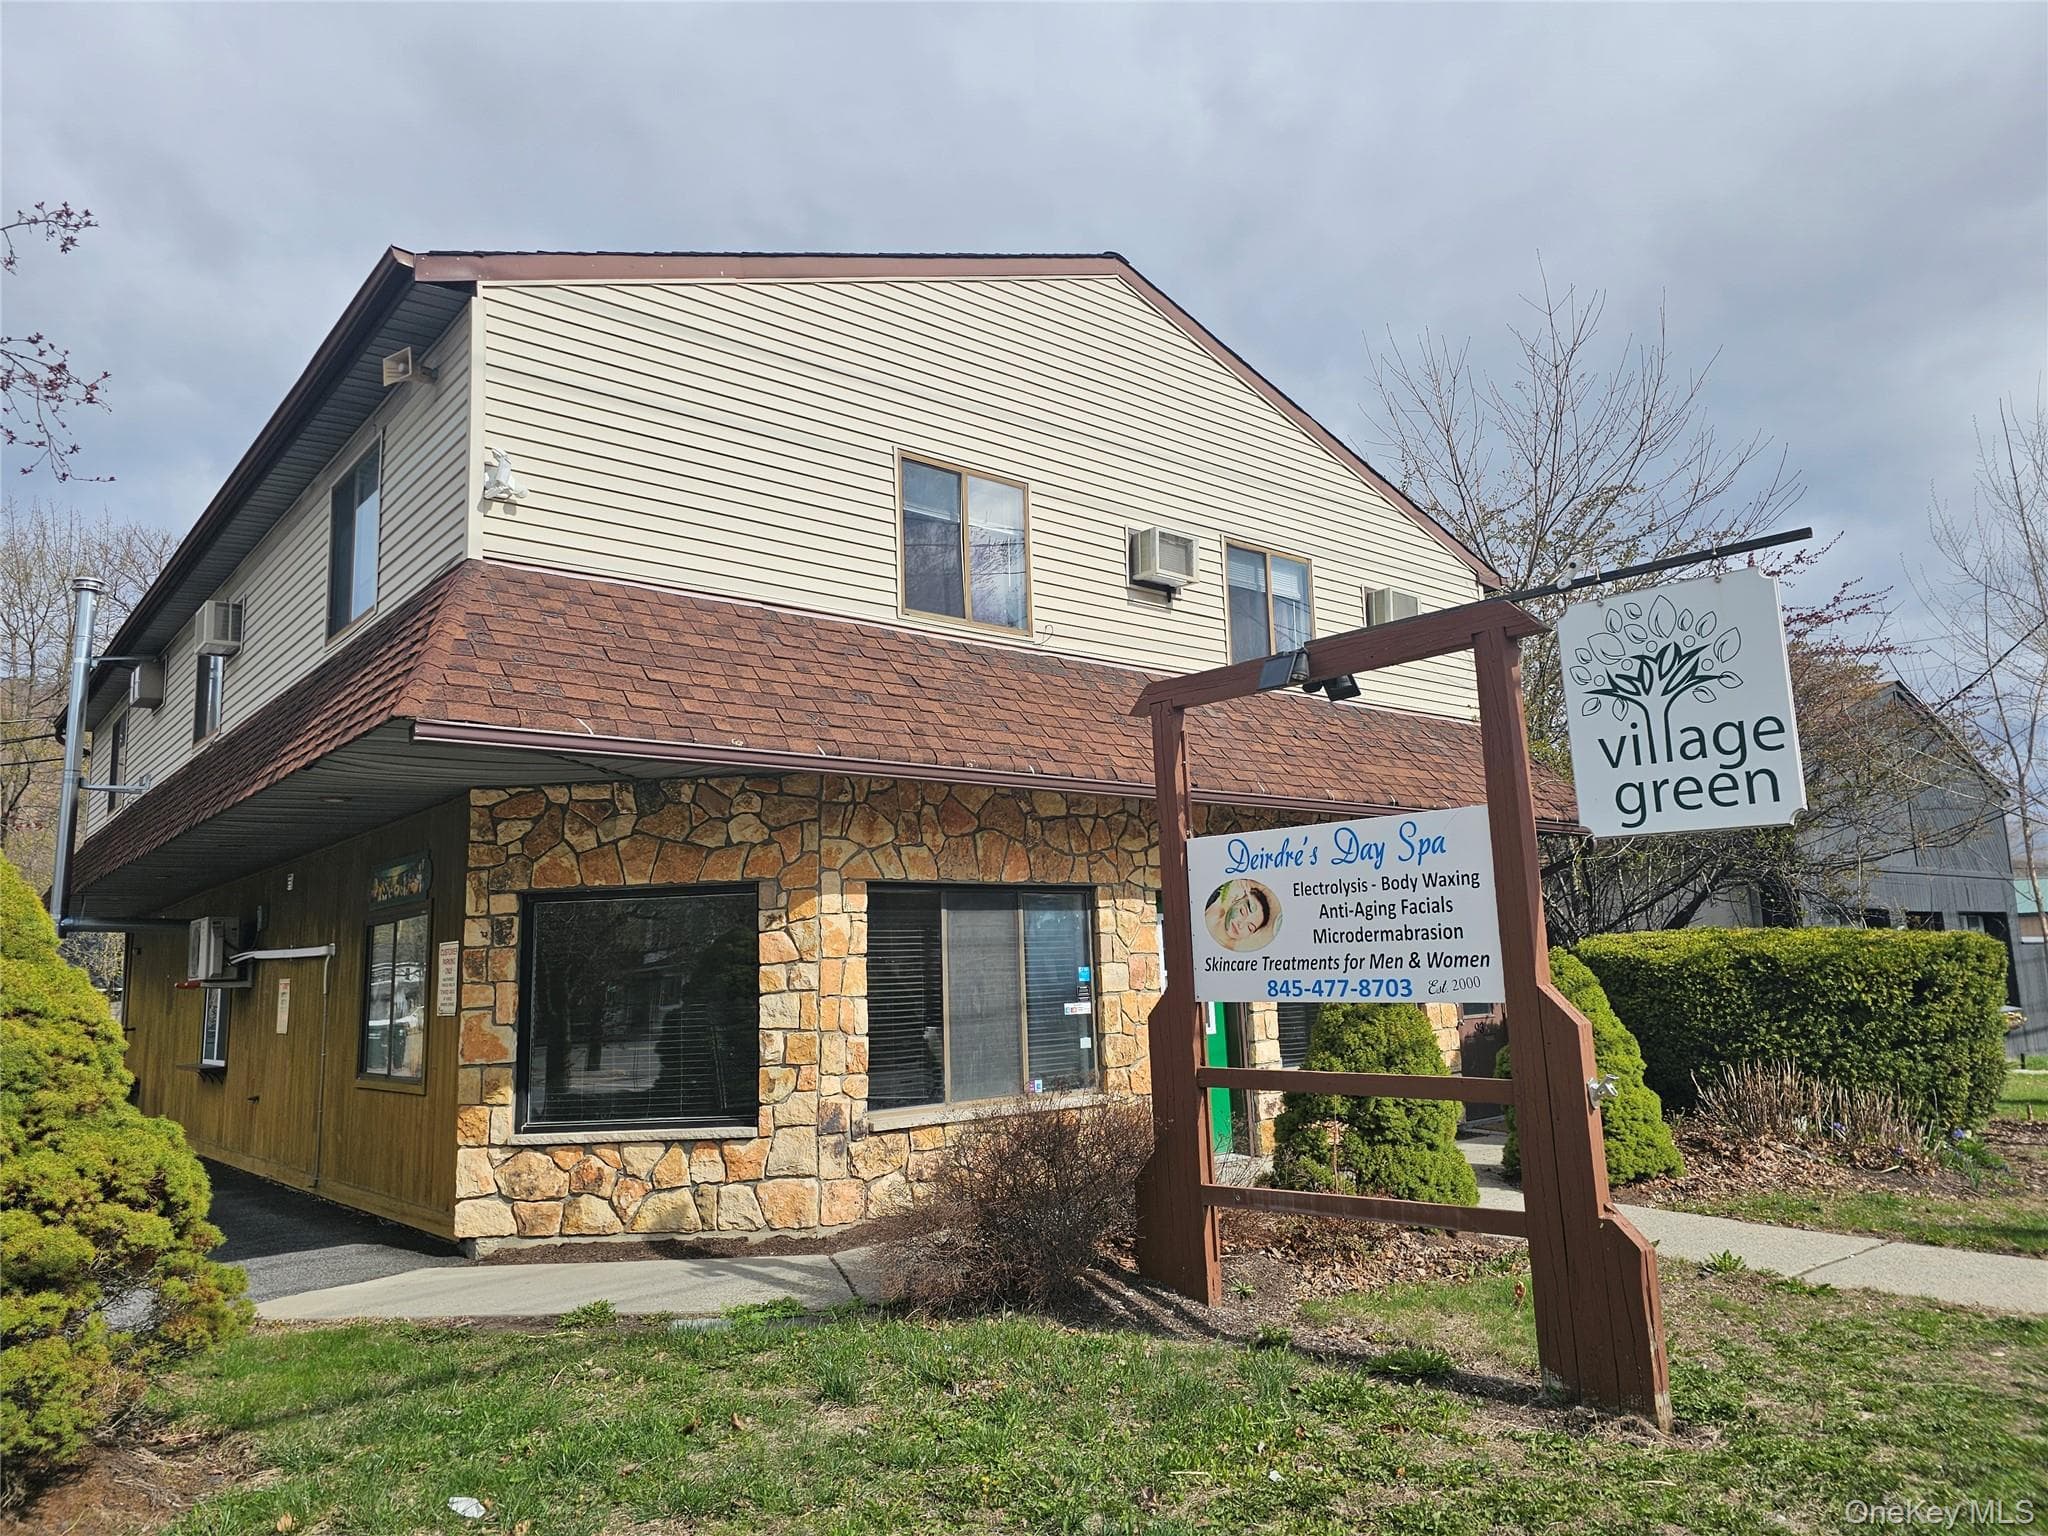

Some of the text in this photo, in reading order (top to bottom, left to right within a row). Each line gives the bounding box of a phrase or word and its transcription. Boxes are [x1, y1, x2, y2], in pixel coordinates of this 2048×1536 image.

[1597, 714, 1785, 770] village
[1614, 767, 1781, 828] green
[1225, 821, 1447, 874] Deirdre's Day Spa
[1292, 876, 1368, 897] Electrolysis
[1381, 873, 1418, 893] Body
[1422, 870, 1480, 888] Waxing
[1319, 896, 1454, 921] Anti-Aging Facials
[1313, 923, 1464, 944] Microdermabrasion
[1204, 951, 1490, 974] Skincare Treatments for Men & Women
[1267, 978, 1413, 998] 845-477-8703
[1451, 975, 1481, 991] 2000
